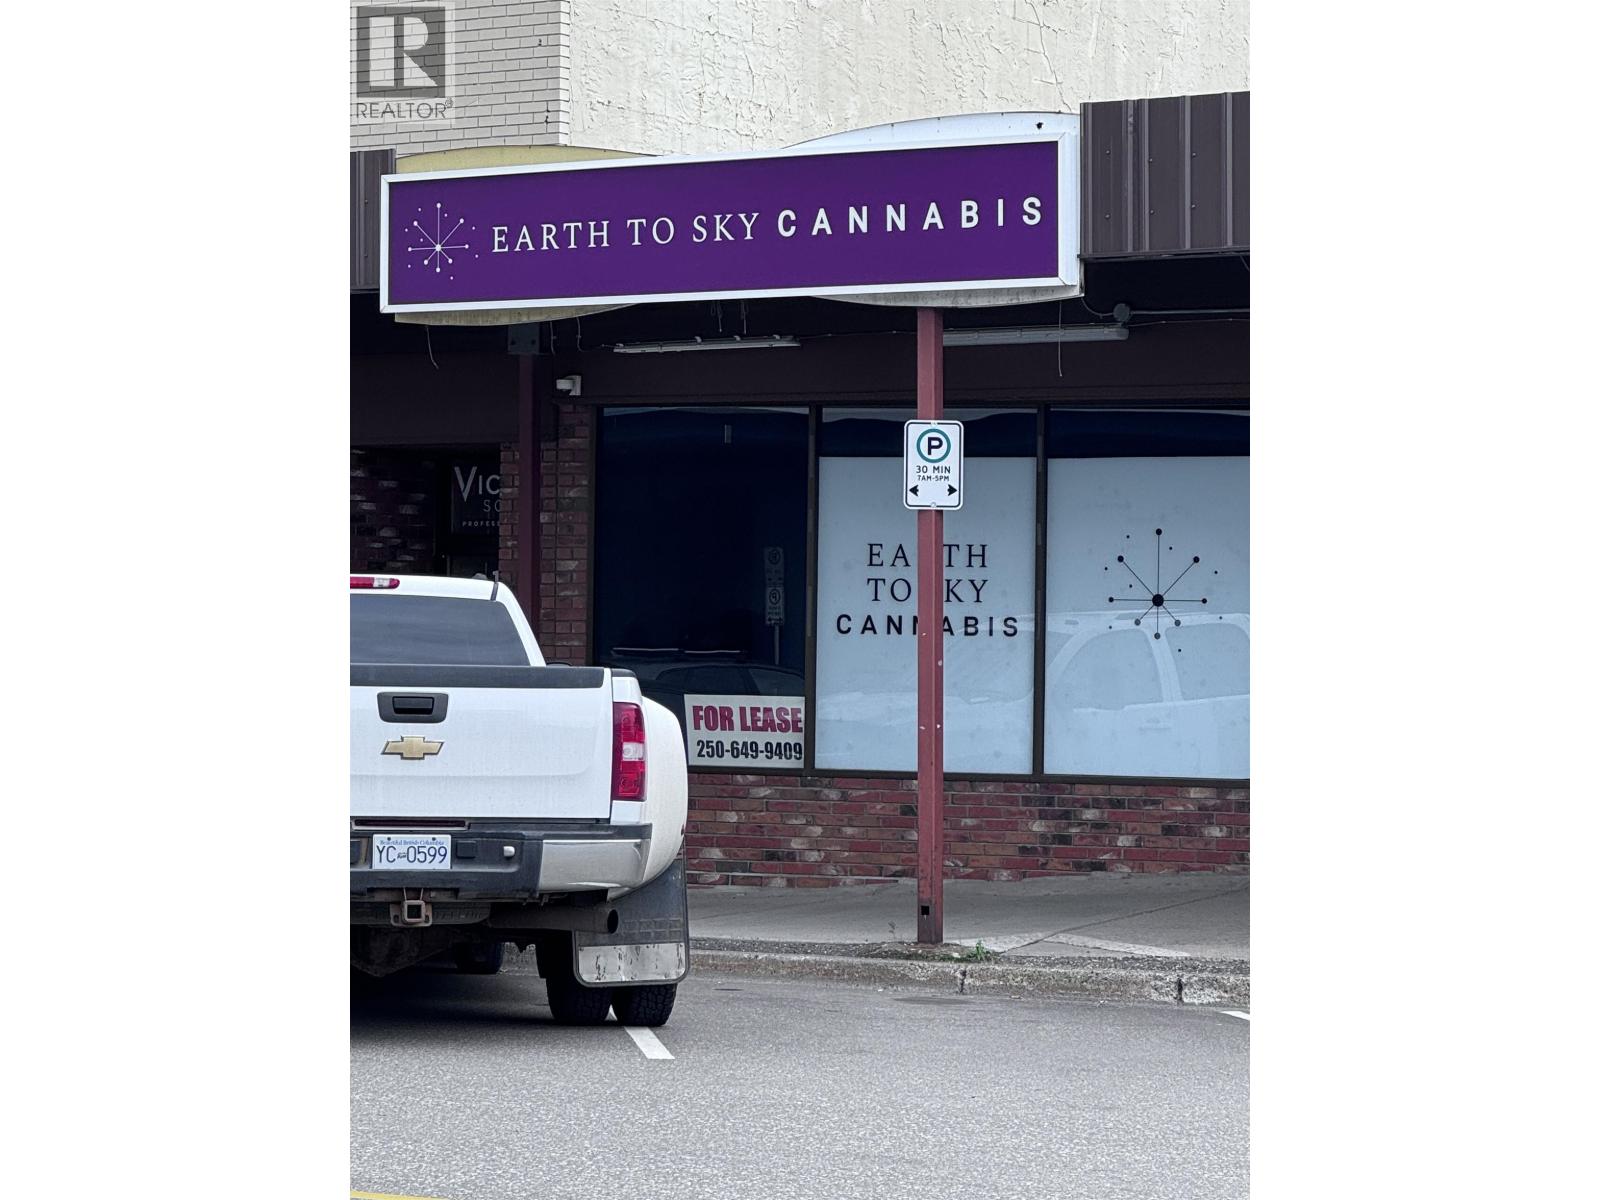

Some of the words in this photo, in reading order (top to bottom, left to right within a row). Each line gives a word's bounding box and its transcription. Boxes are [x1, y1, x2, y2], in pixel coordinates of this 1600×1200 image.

[492, 220, 610, 253] EARTH
[626, 217, 675, 246] TO
[692, 212, 760, 243] SKY
[777, 196, 1042, 238] CANNABIS
[927, 436, 944, 456] P
[915, 465, 928, 474] 30
[932, 465, 951, 474] MIN
[917, 474, 950, 482] 7AM-5PM
[866, 543, 988, 568] EATH
[867, 578, 912, 602] TO
[944, 579, 989, 603] KY
[692, 705, 735, 731] FOR
[739, 706, 803, 733] LEASE
[696, 740, 803, 760] 250-649-9409
